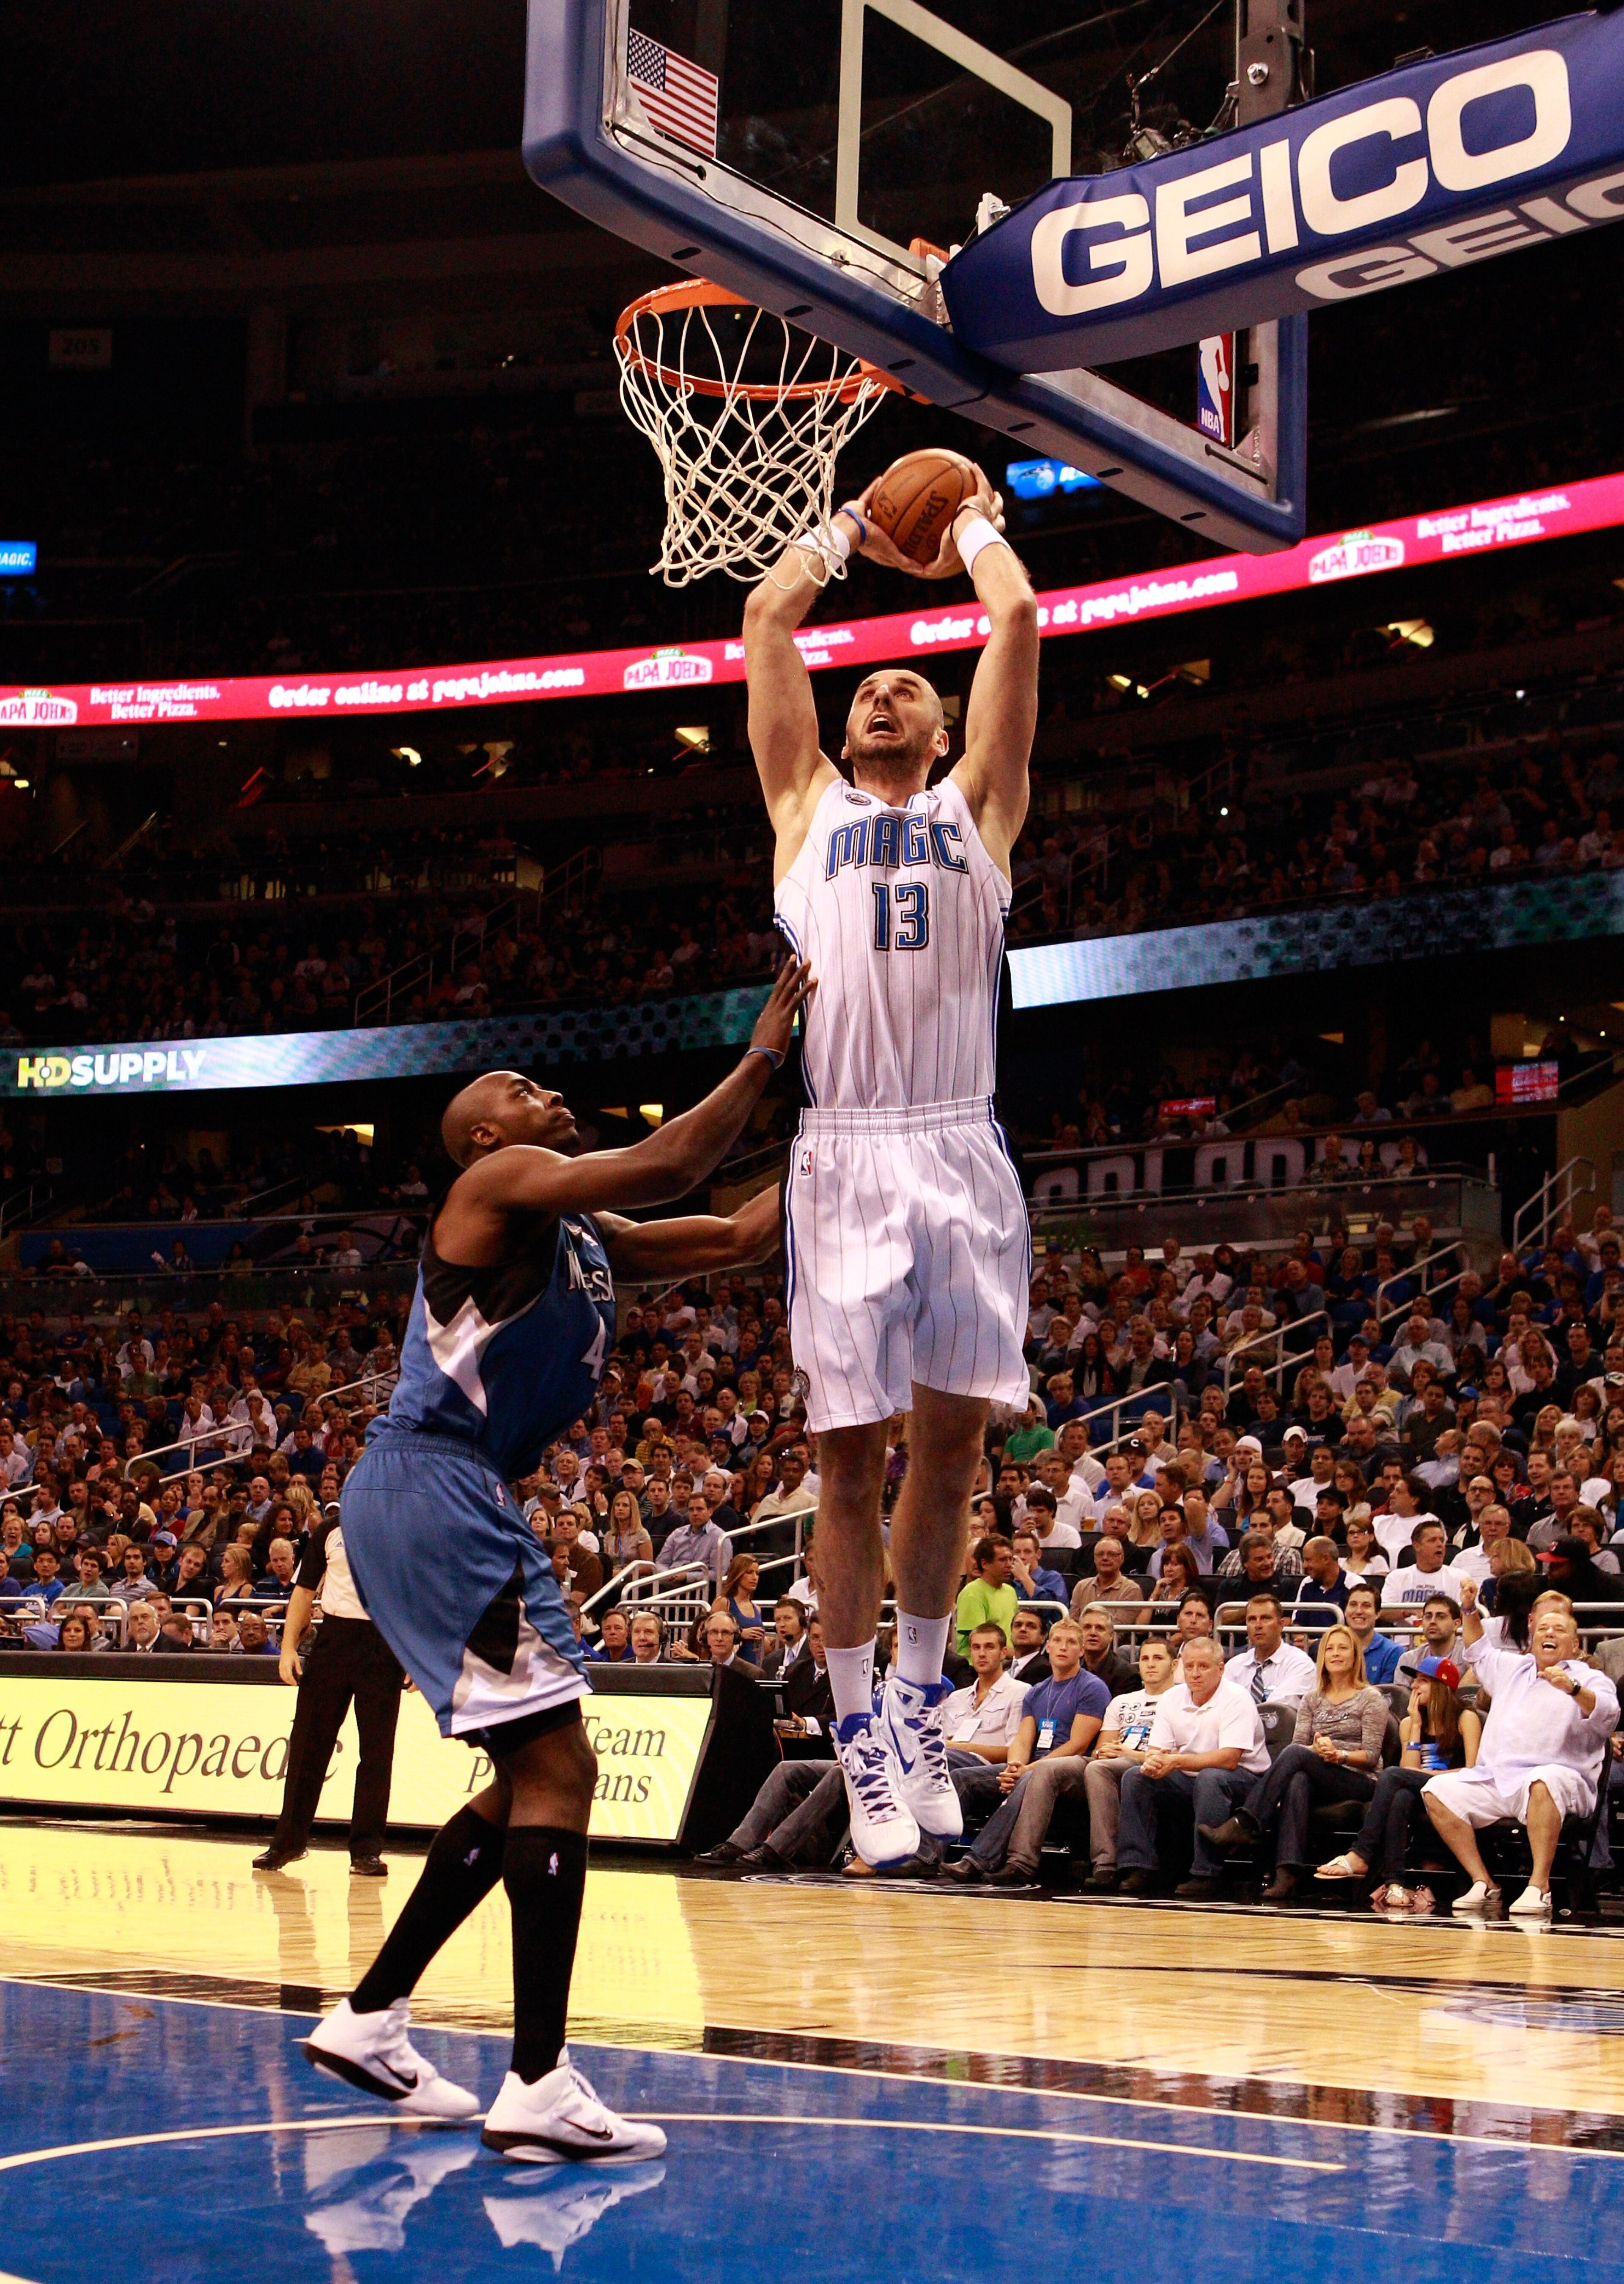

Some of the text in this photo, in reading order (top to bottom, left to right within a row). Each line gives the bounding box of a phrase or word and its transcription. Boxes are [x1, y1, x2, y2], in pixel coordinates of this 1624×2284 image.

[1031, 49, 1572, 316] GEICO
[1201, 407, 1220, 434] NBA
[1417, 493, 1570, 538] Better Ingredients.
[1442, 519, 1544, 552] Better Pizza.
[910, 617, 973, 645] Order
[1052, 599, 1078, 623] at
[1080, 571, 1238, 624] papajohns.com
[269, 668, 584, 708] Order online at papajohns.com
[626, 662, 660, 684] PAPA
[90, 684, 220, 704] Better Ingredients.
[111, 701, 198, 719] Better Pizza.
[872, 881, 929, 952] 13
[1130, 1439, 1139, 1447] C
